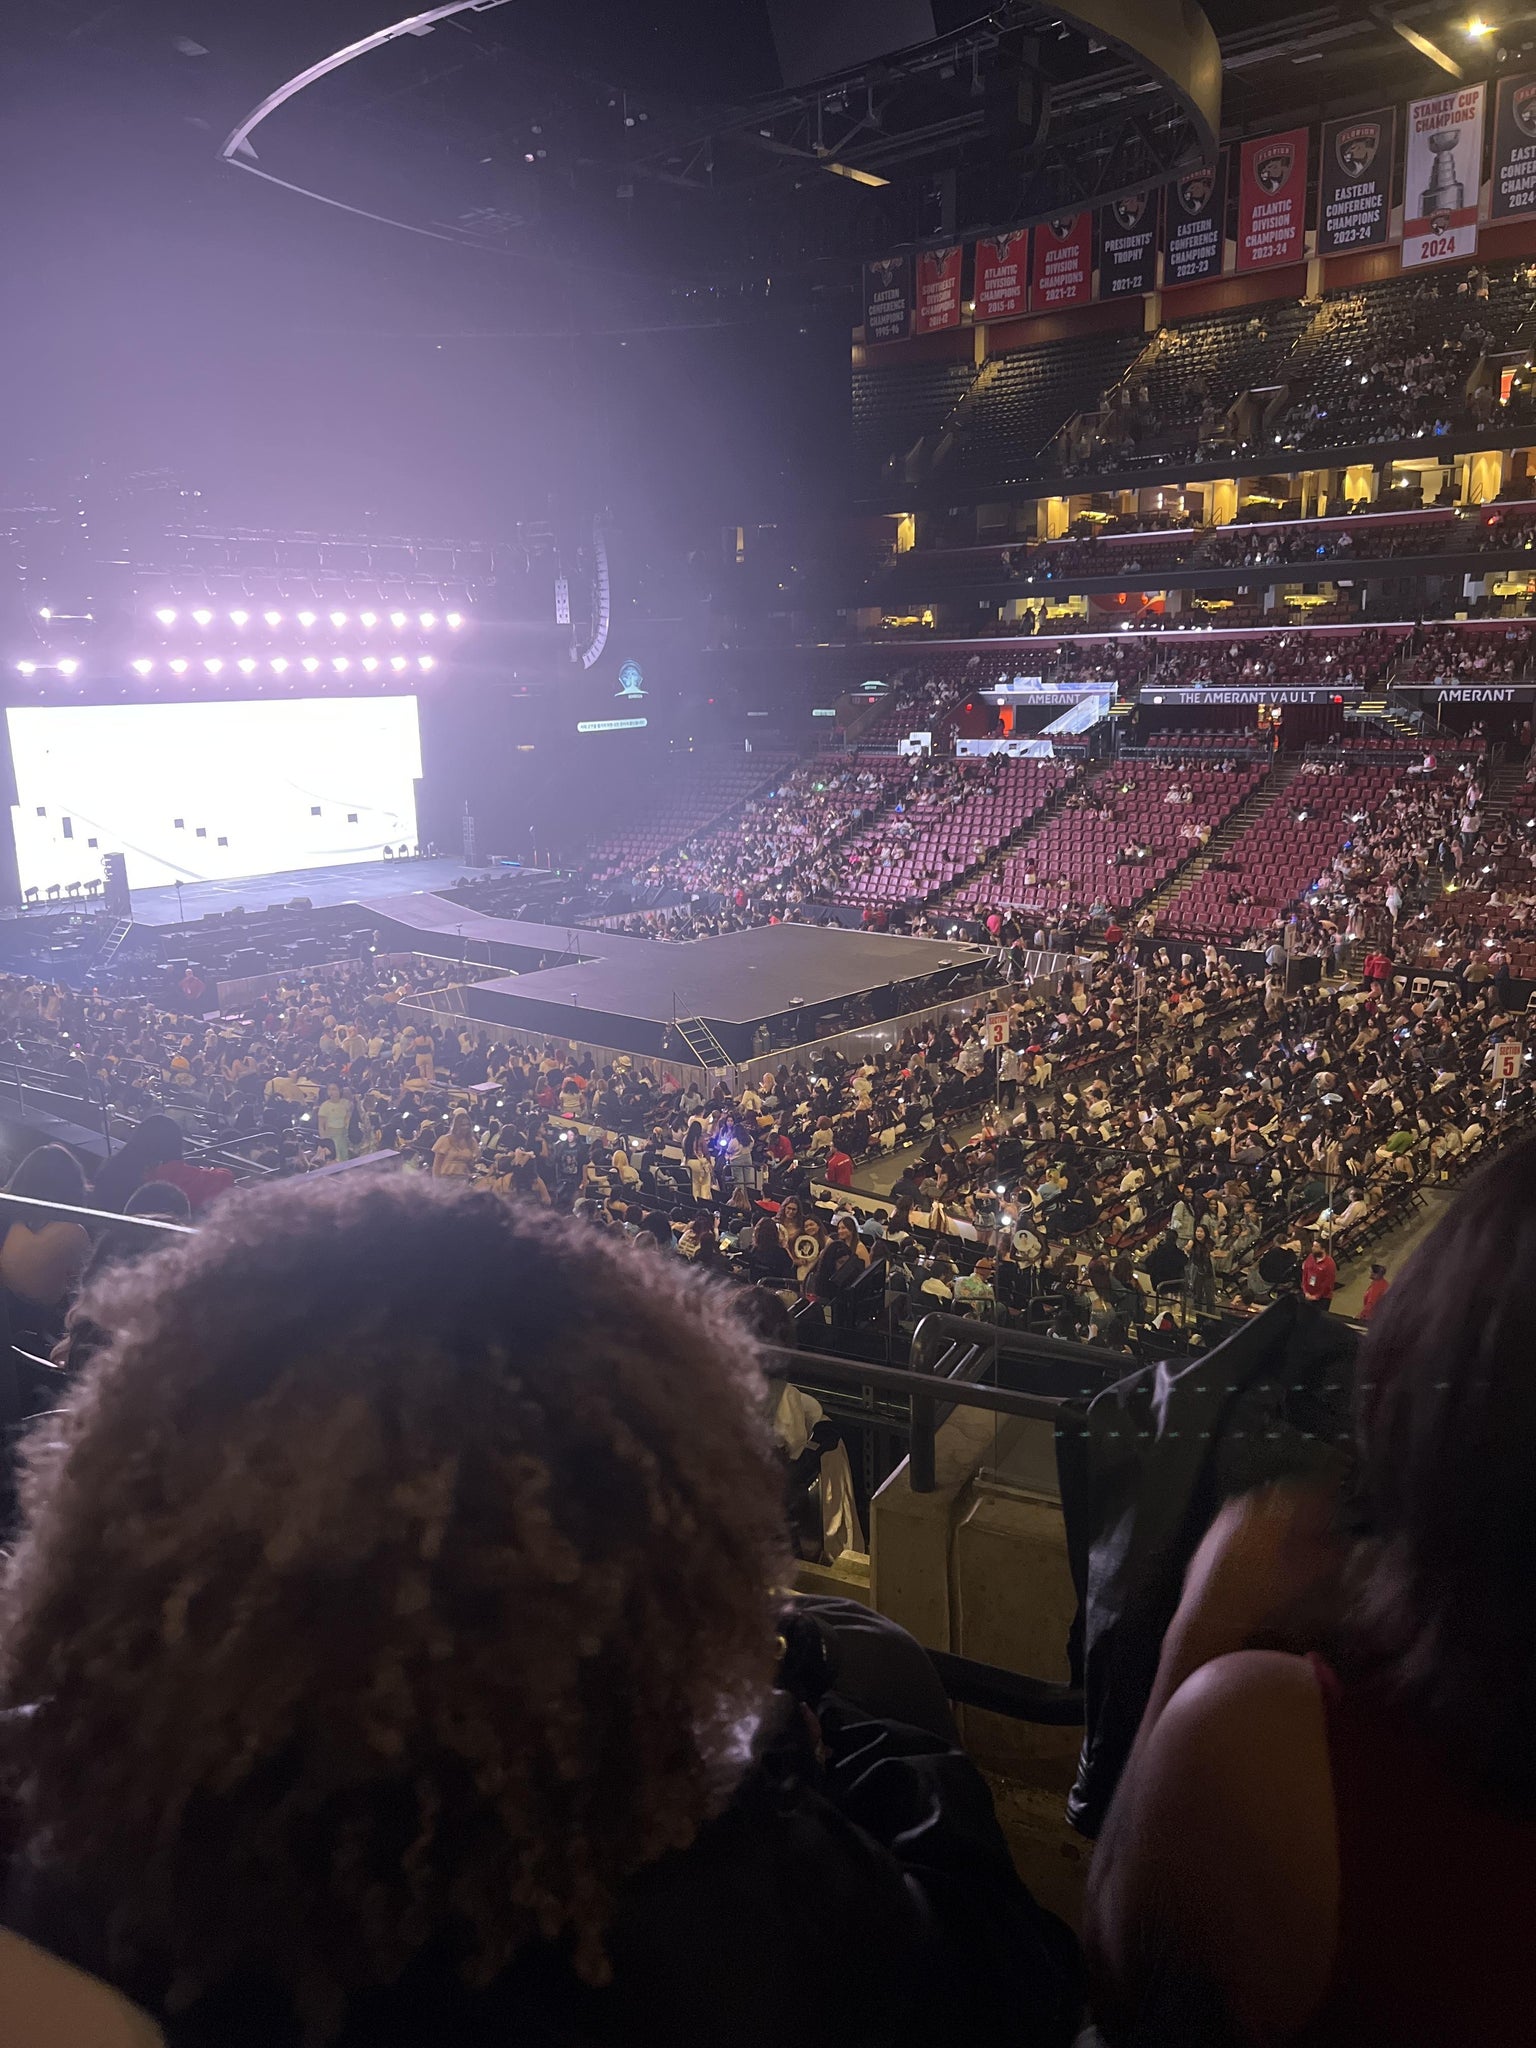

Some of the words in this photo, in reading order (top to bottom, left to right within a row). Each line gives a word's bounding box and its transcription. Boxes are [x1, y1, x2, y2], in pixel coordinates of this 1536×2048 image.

[1413, 98, 1455, 120] STANLEY
[1458, 91, 1479, 108] CUP
[1415, 107, 1476, 133] CHAMPIONS
[1511, 145, 1536, 162] EAST
[1500, 160, 1536, 179] CONFE
[1335, 181, 1375, 201] EASTERN
[1501, 175, 1536, 194] CHAMP
[1326, 194, 1383, 217] CONFERENCE
[1509, 191, 1536, 208] 2024
[1252, 199, 1293, 219] ATLANTIC
[1177, 218, 1212, 237] EASTERN
[1252, 214, 1290, 232] DIVISION
[1326, 210, 1380, 232] CHAMPIONS
[1105, 231, 1153, 252] PRESIDENTS'
[1170, 230, 1218, 252] CONFERENCE
[1245, 226, 1296, 247] CHAMPIONS
[1333, 226, 1371, 244] 2023-24
[1045, 245, 1080, 263] ATLANTIC
[1113, 248, 1143, 264] TROPHY
[1170, 244, 1216, 265] CHAMPIONS
[1252, 243, 1287, 260] 2023-24
[1421, 236, 1456, 259] 2024
[984, 264, 1018, 280] ATLANTIC
[1045, 259, 1078, 275] DIVISION
[1177, 260, 1209, 277] 2022-23
[985, 276, 1016, 290] DIVISION
[1039, 271, 1083, 289] CHAMPIONS
[1112, 276, 1142, 292] 2021-22
[980, 285, 1021, 302] CHAMPIONS
[1046, 286, 1076, 301] 2021-22
[1027, 694, 1080, 704] AMERANT
[1179, 693, 1200, 704] THE
[1203, 692, 1266, 704] AMERANT
[1270, 691, 1317, 703] VAULT
[1437, 689, 1515, 702] AMERANT
[994, 1025, 1003, 1042] 3
[1503, 1056, 1514, 1076] 5
